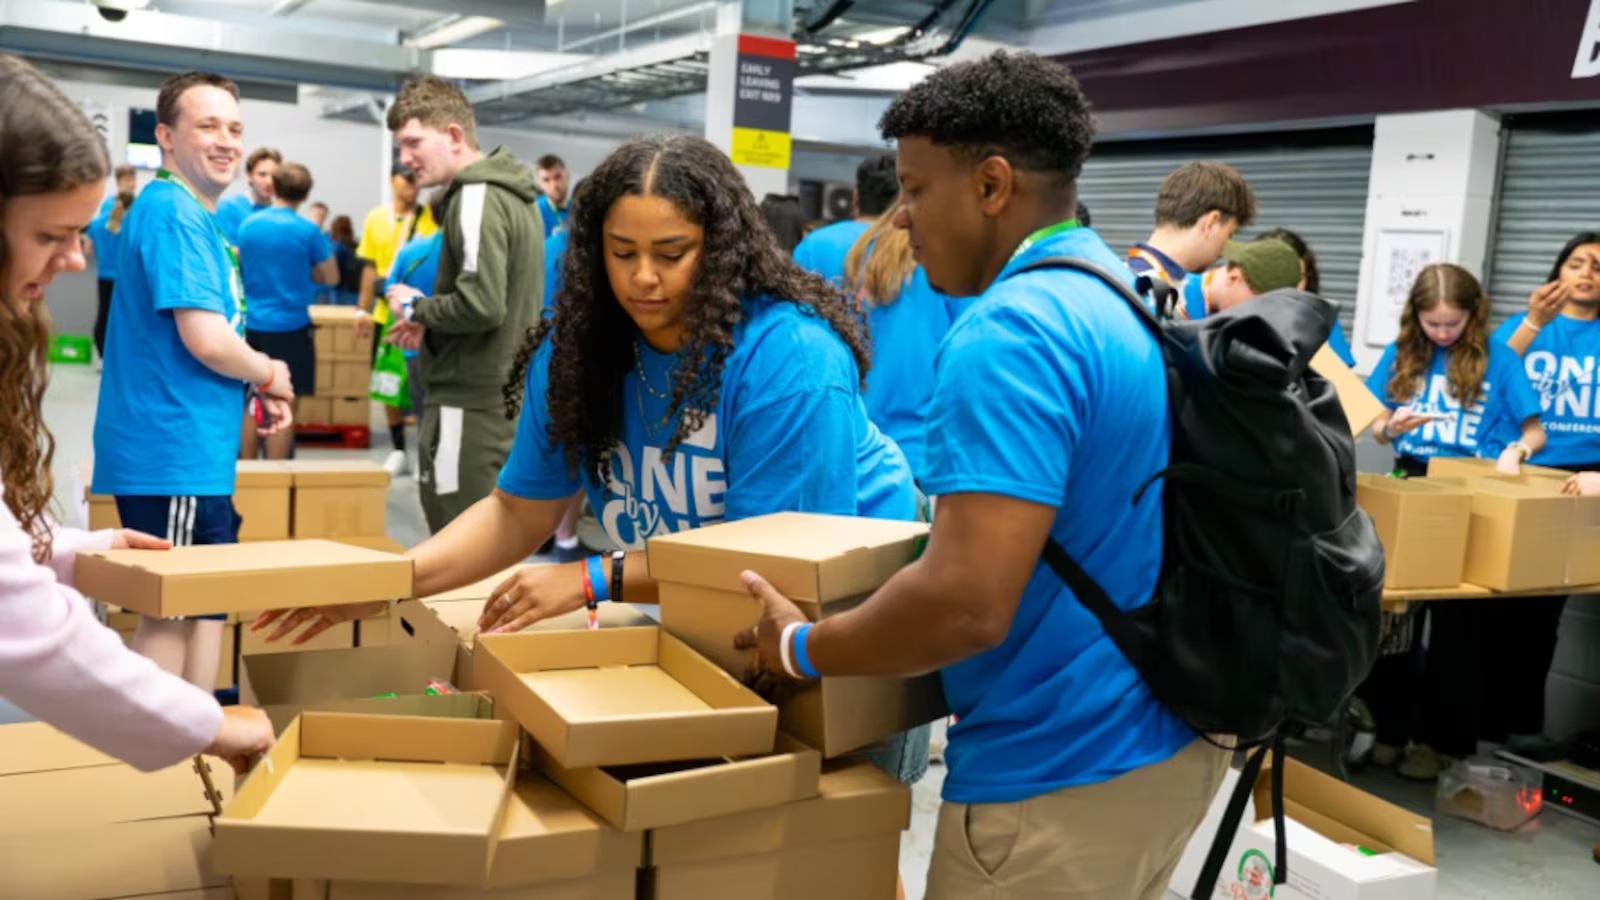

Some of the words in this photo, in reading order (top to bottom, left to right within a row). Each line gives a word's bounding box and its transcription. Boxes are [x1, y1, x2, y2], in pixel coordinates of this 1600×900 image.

[741, 63, 771, 75] EARLY
[740, 76, 781, 90] LEAVING
[740, 88, 760, 100] EXIT
[1524, 351, 1600, 385] ON
[598, 441, 728, 518] ONE
[624, 481, 660, 538] by
